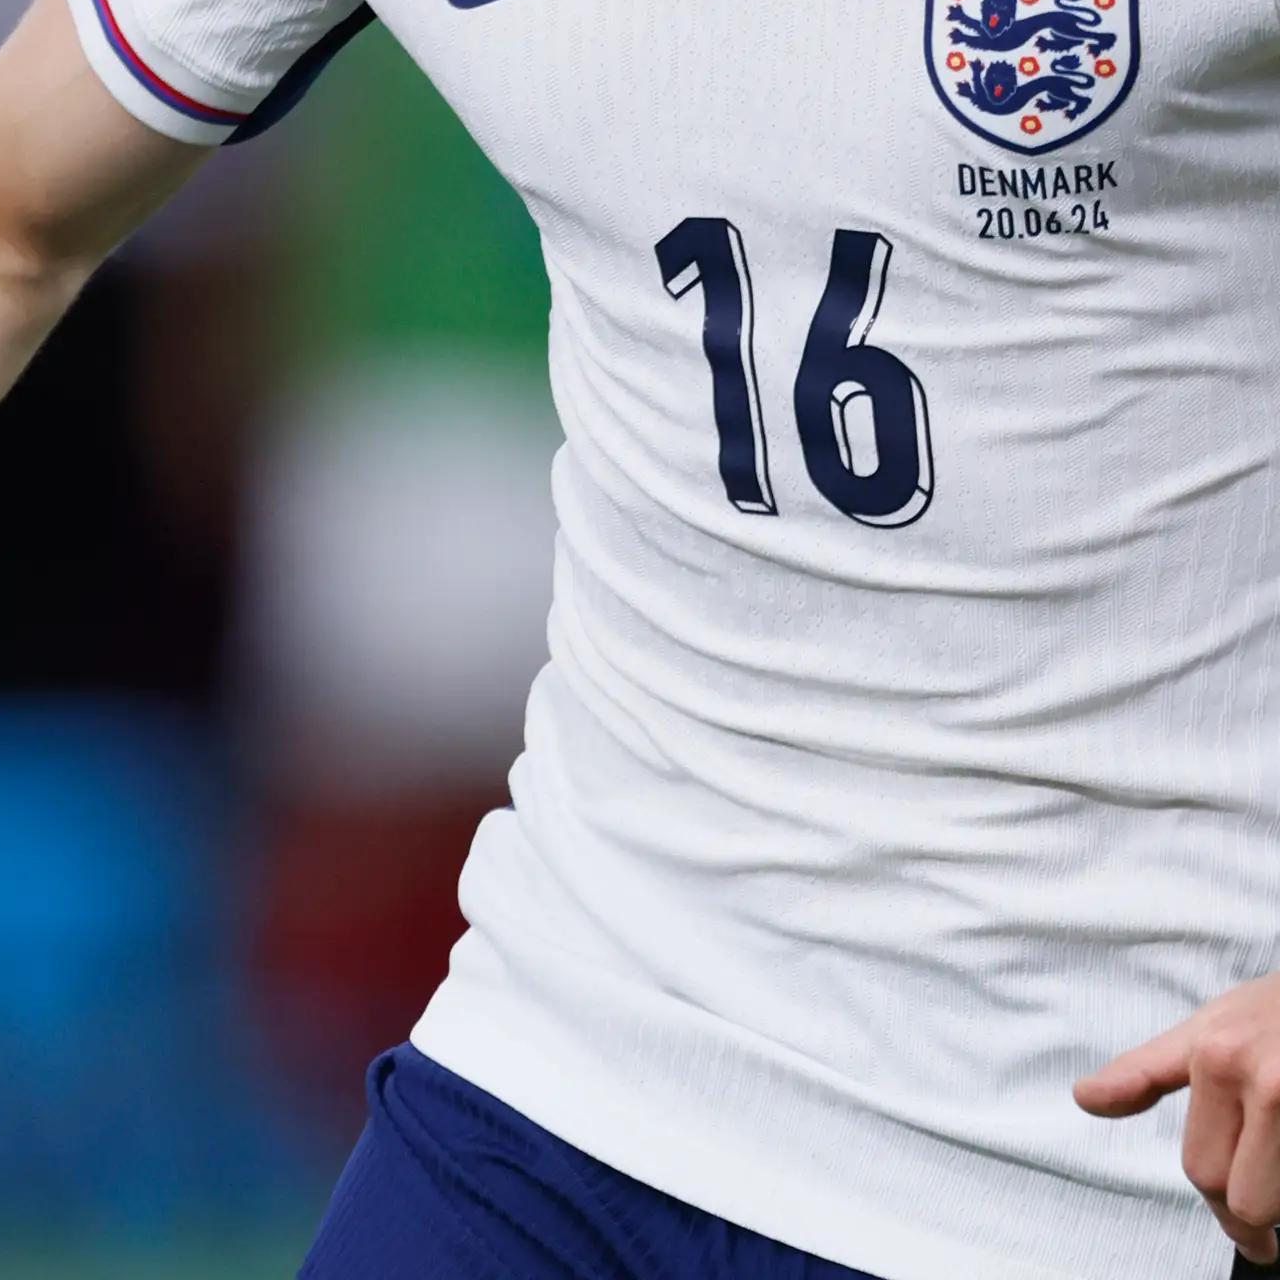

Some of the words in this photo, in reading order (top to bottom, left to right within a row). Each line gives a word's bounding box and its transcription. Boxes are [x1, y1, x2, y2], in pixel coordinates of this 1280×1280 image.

[958, 161, 1118, 200] DENMARK
[976, 199, 1109, 239] 20.06.24
[654, 217, 935, 529] 16
